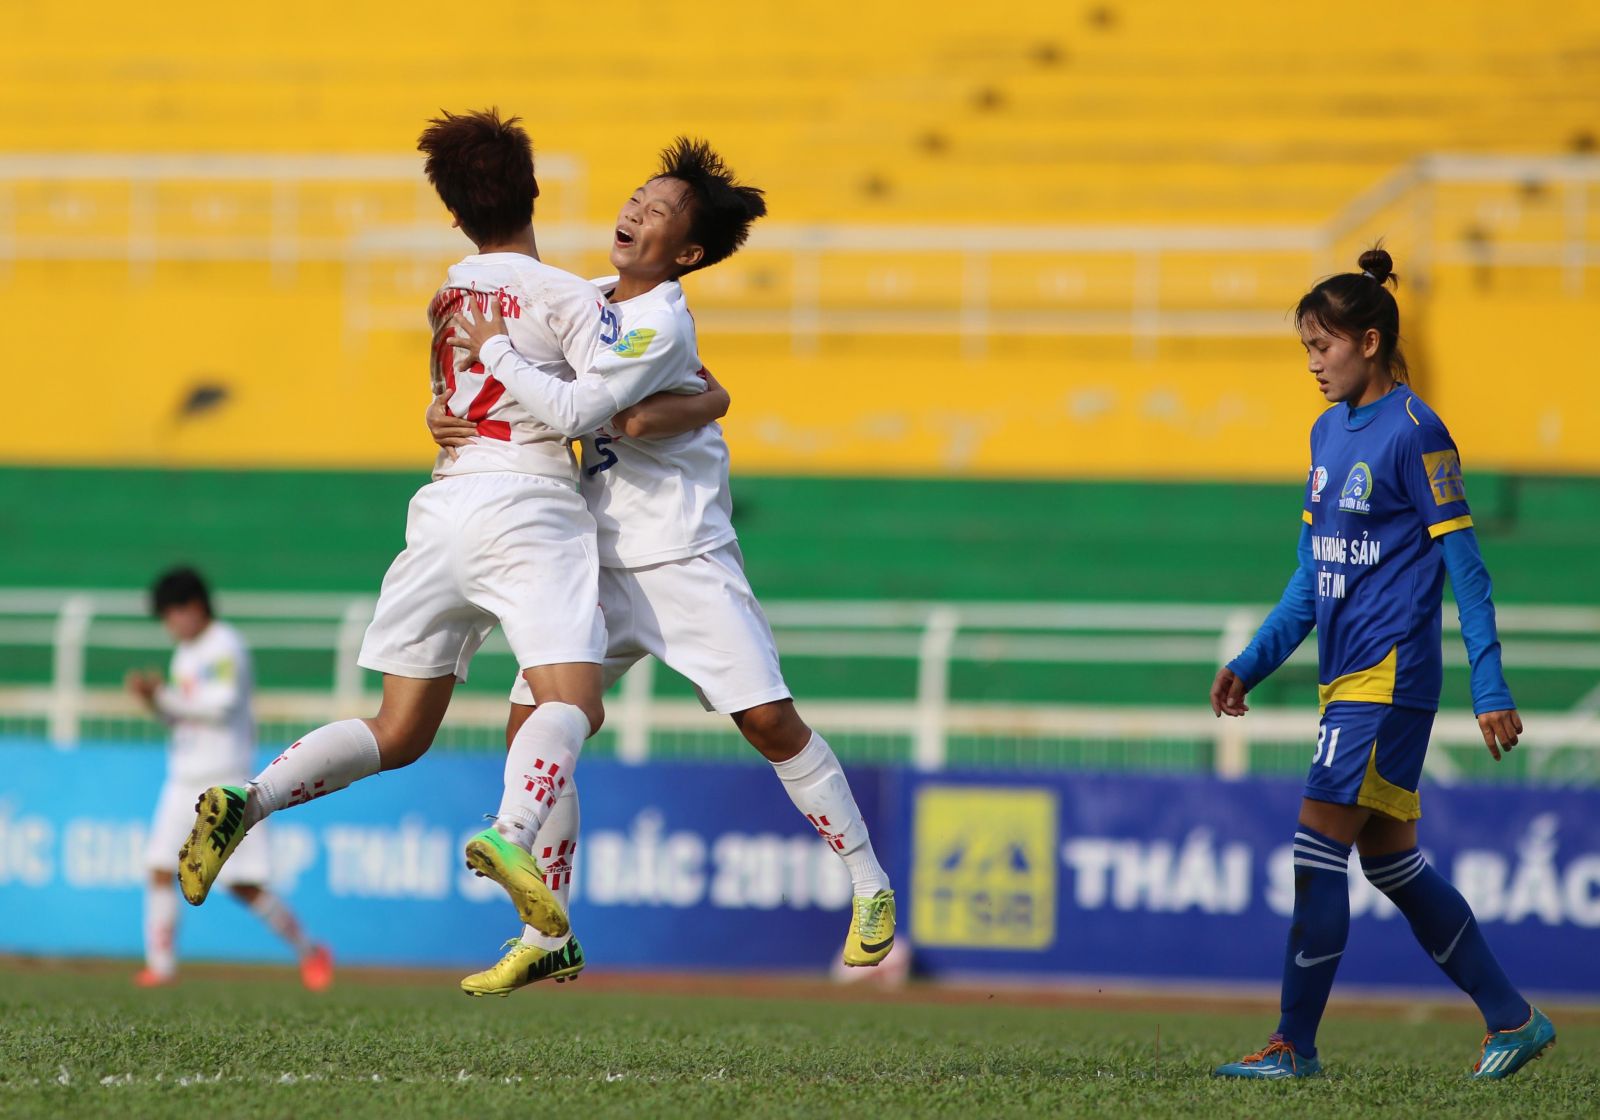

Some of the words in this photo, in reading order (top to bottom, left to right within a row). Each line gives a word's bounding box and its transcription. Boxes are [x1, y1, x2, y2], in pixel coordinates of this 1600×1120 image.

[1350, 530, 1380, 565] SẢN
[1312, 725, 1341, 767] 31
[207, 787, 247, 859] NIKE
[1063, 829, 1252, 912] THÁI
[526, 935, 584, 982] NIKE
